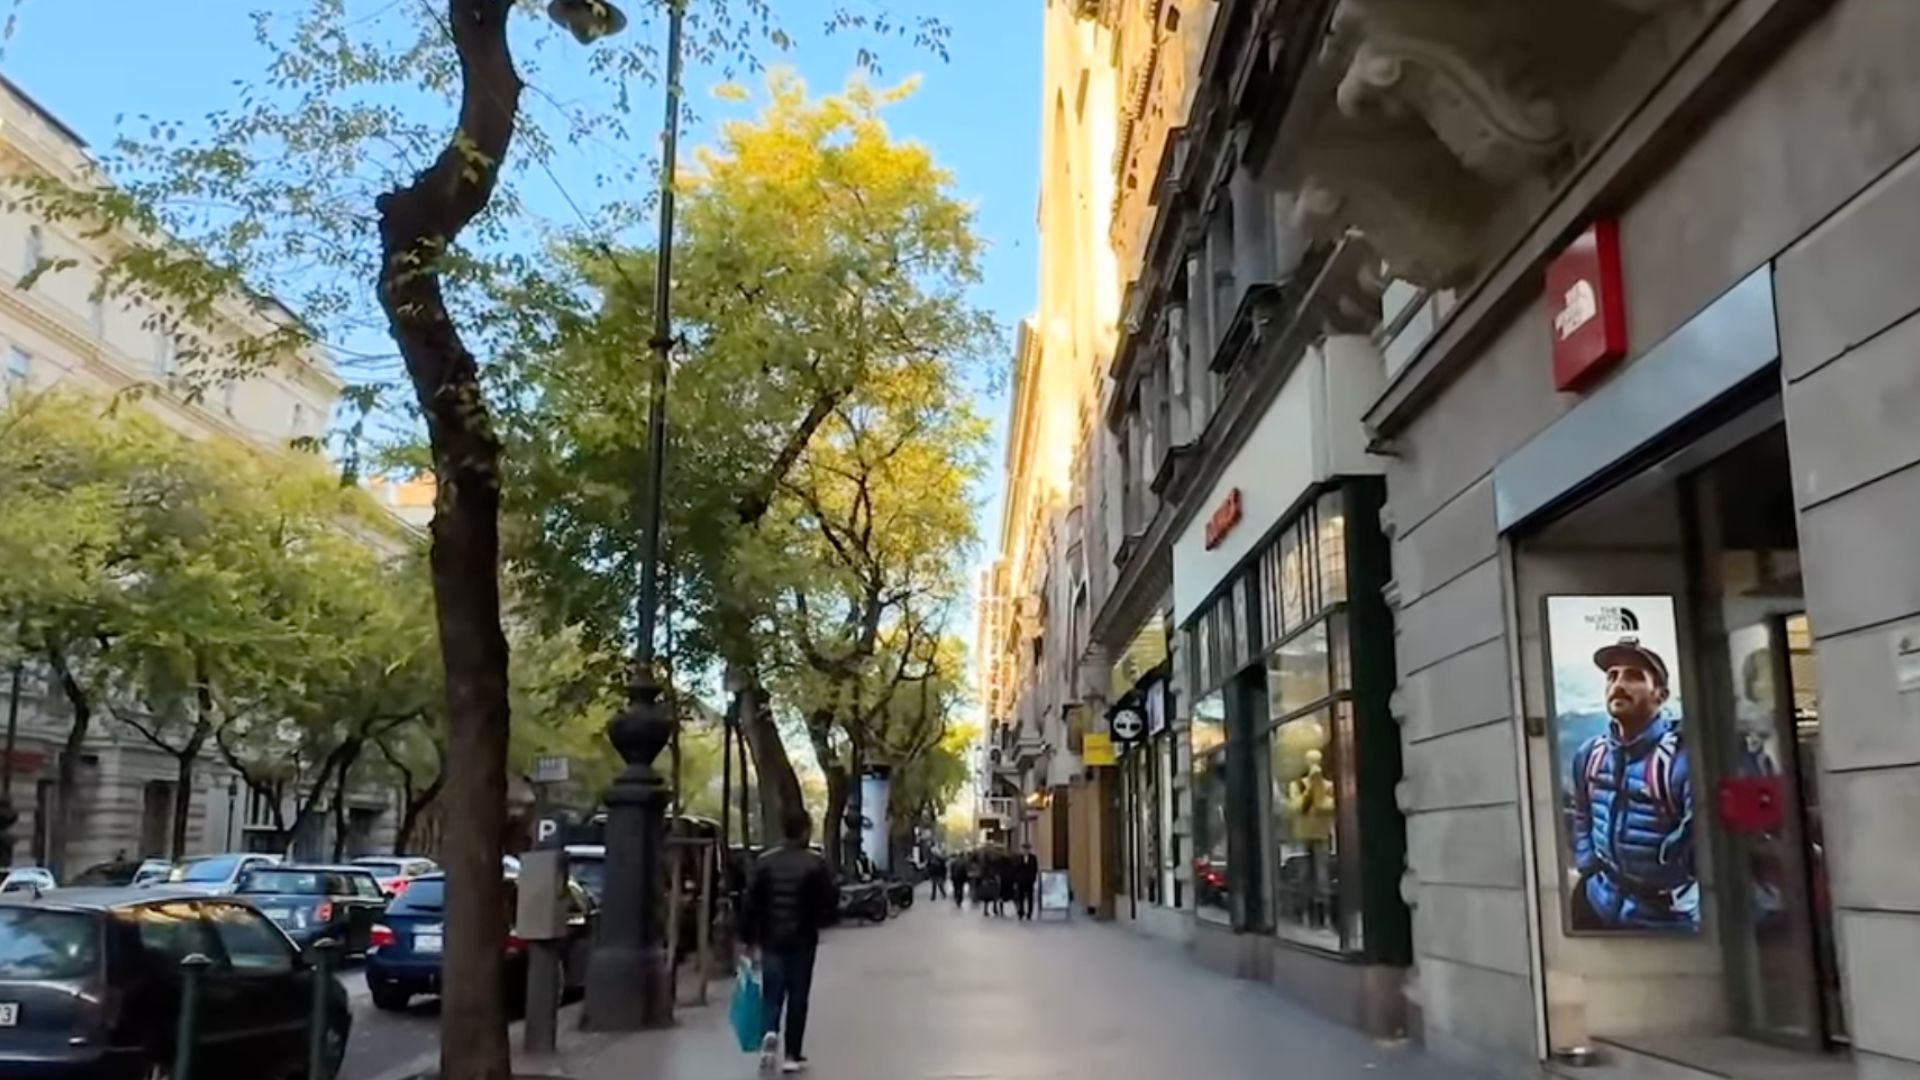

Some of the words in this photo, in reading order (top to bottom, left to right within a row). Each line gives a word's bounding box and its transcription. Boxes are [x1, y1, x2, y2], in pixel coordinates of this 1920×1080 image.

[1601, 606, 1618, 615] THE
[1584, 614, 1620, 623] NORTH
[1595, 622, 1619, 631] FACE
[539, 819, 556, 841] P
